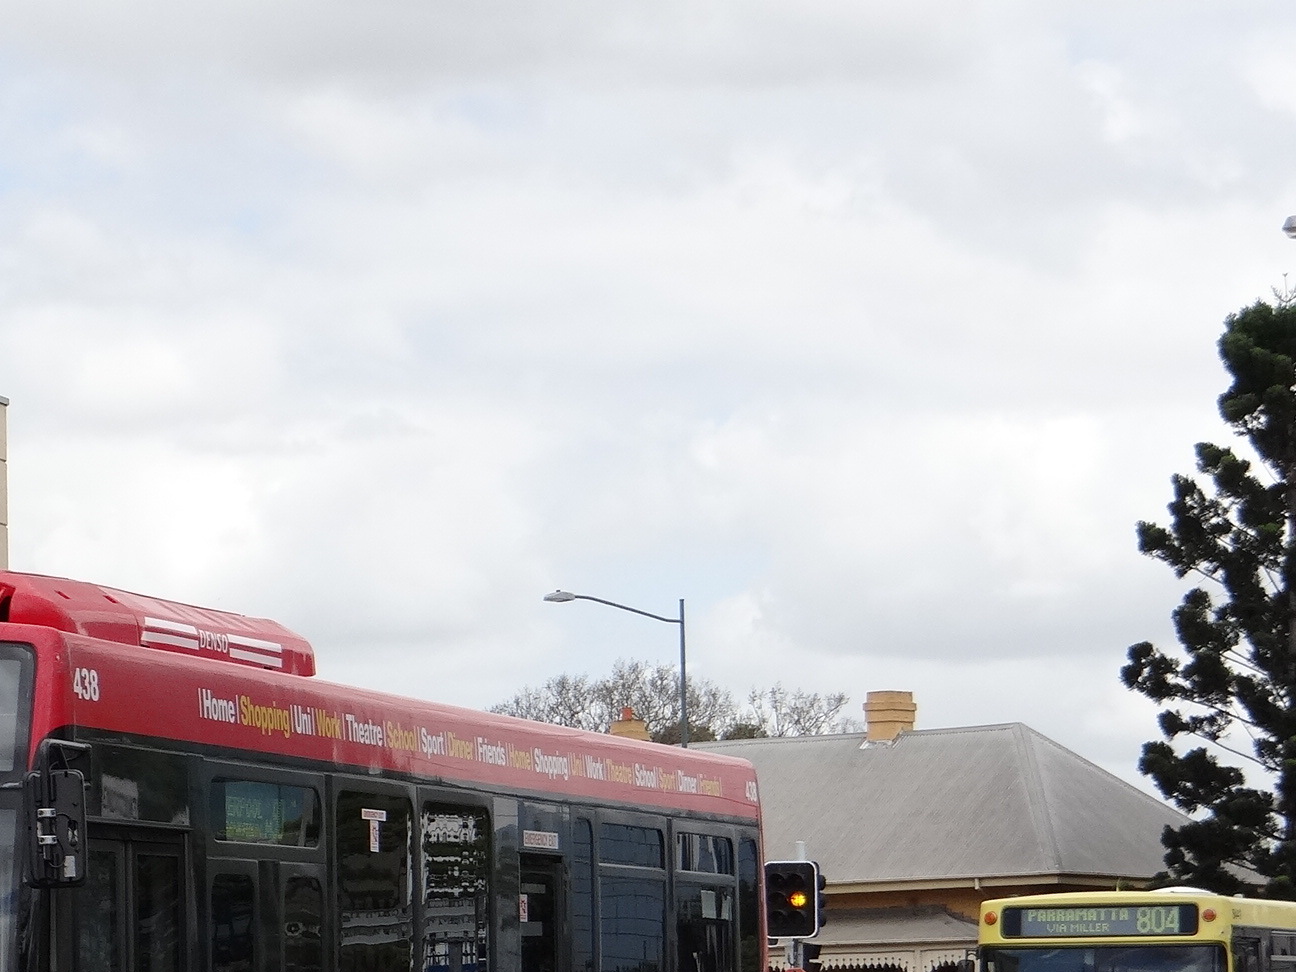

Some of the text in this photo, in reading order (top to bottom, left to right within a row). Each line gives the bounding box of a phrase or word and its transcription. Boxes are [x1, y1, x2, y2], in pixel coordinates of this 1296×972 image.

[199, 629, 228, 653] DENSO
[73, 668, 100, 701] 438
[203, 689, 235, 723] Home
[240, 695, 290, 738] Shopping
[294, 705, 312, 735] Uni
[316, 708, 341, 739] Work
[346, 713, 383, 747] Theatre
[387, 721, 417, 751] School
[421, 727, 444, 759] Sport
[448, 732, 473, 760] Dinner
[477, 737, 506, 766] Friends
[508, 742, 531, 770] Home
[534, 747, 568, 781] Shopping
[585, 754, 604, 781] Work
[606, 758, 632, 785] Theatre
[634, 763, 657, 788] School
[659, 768, 676, 793] Sport
[677, 769, 697, 794] Dinner
[1047, 923, 1110, 933] VIA MILLER
[1136, 906, 1180, 933] 804
